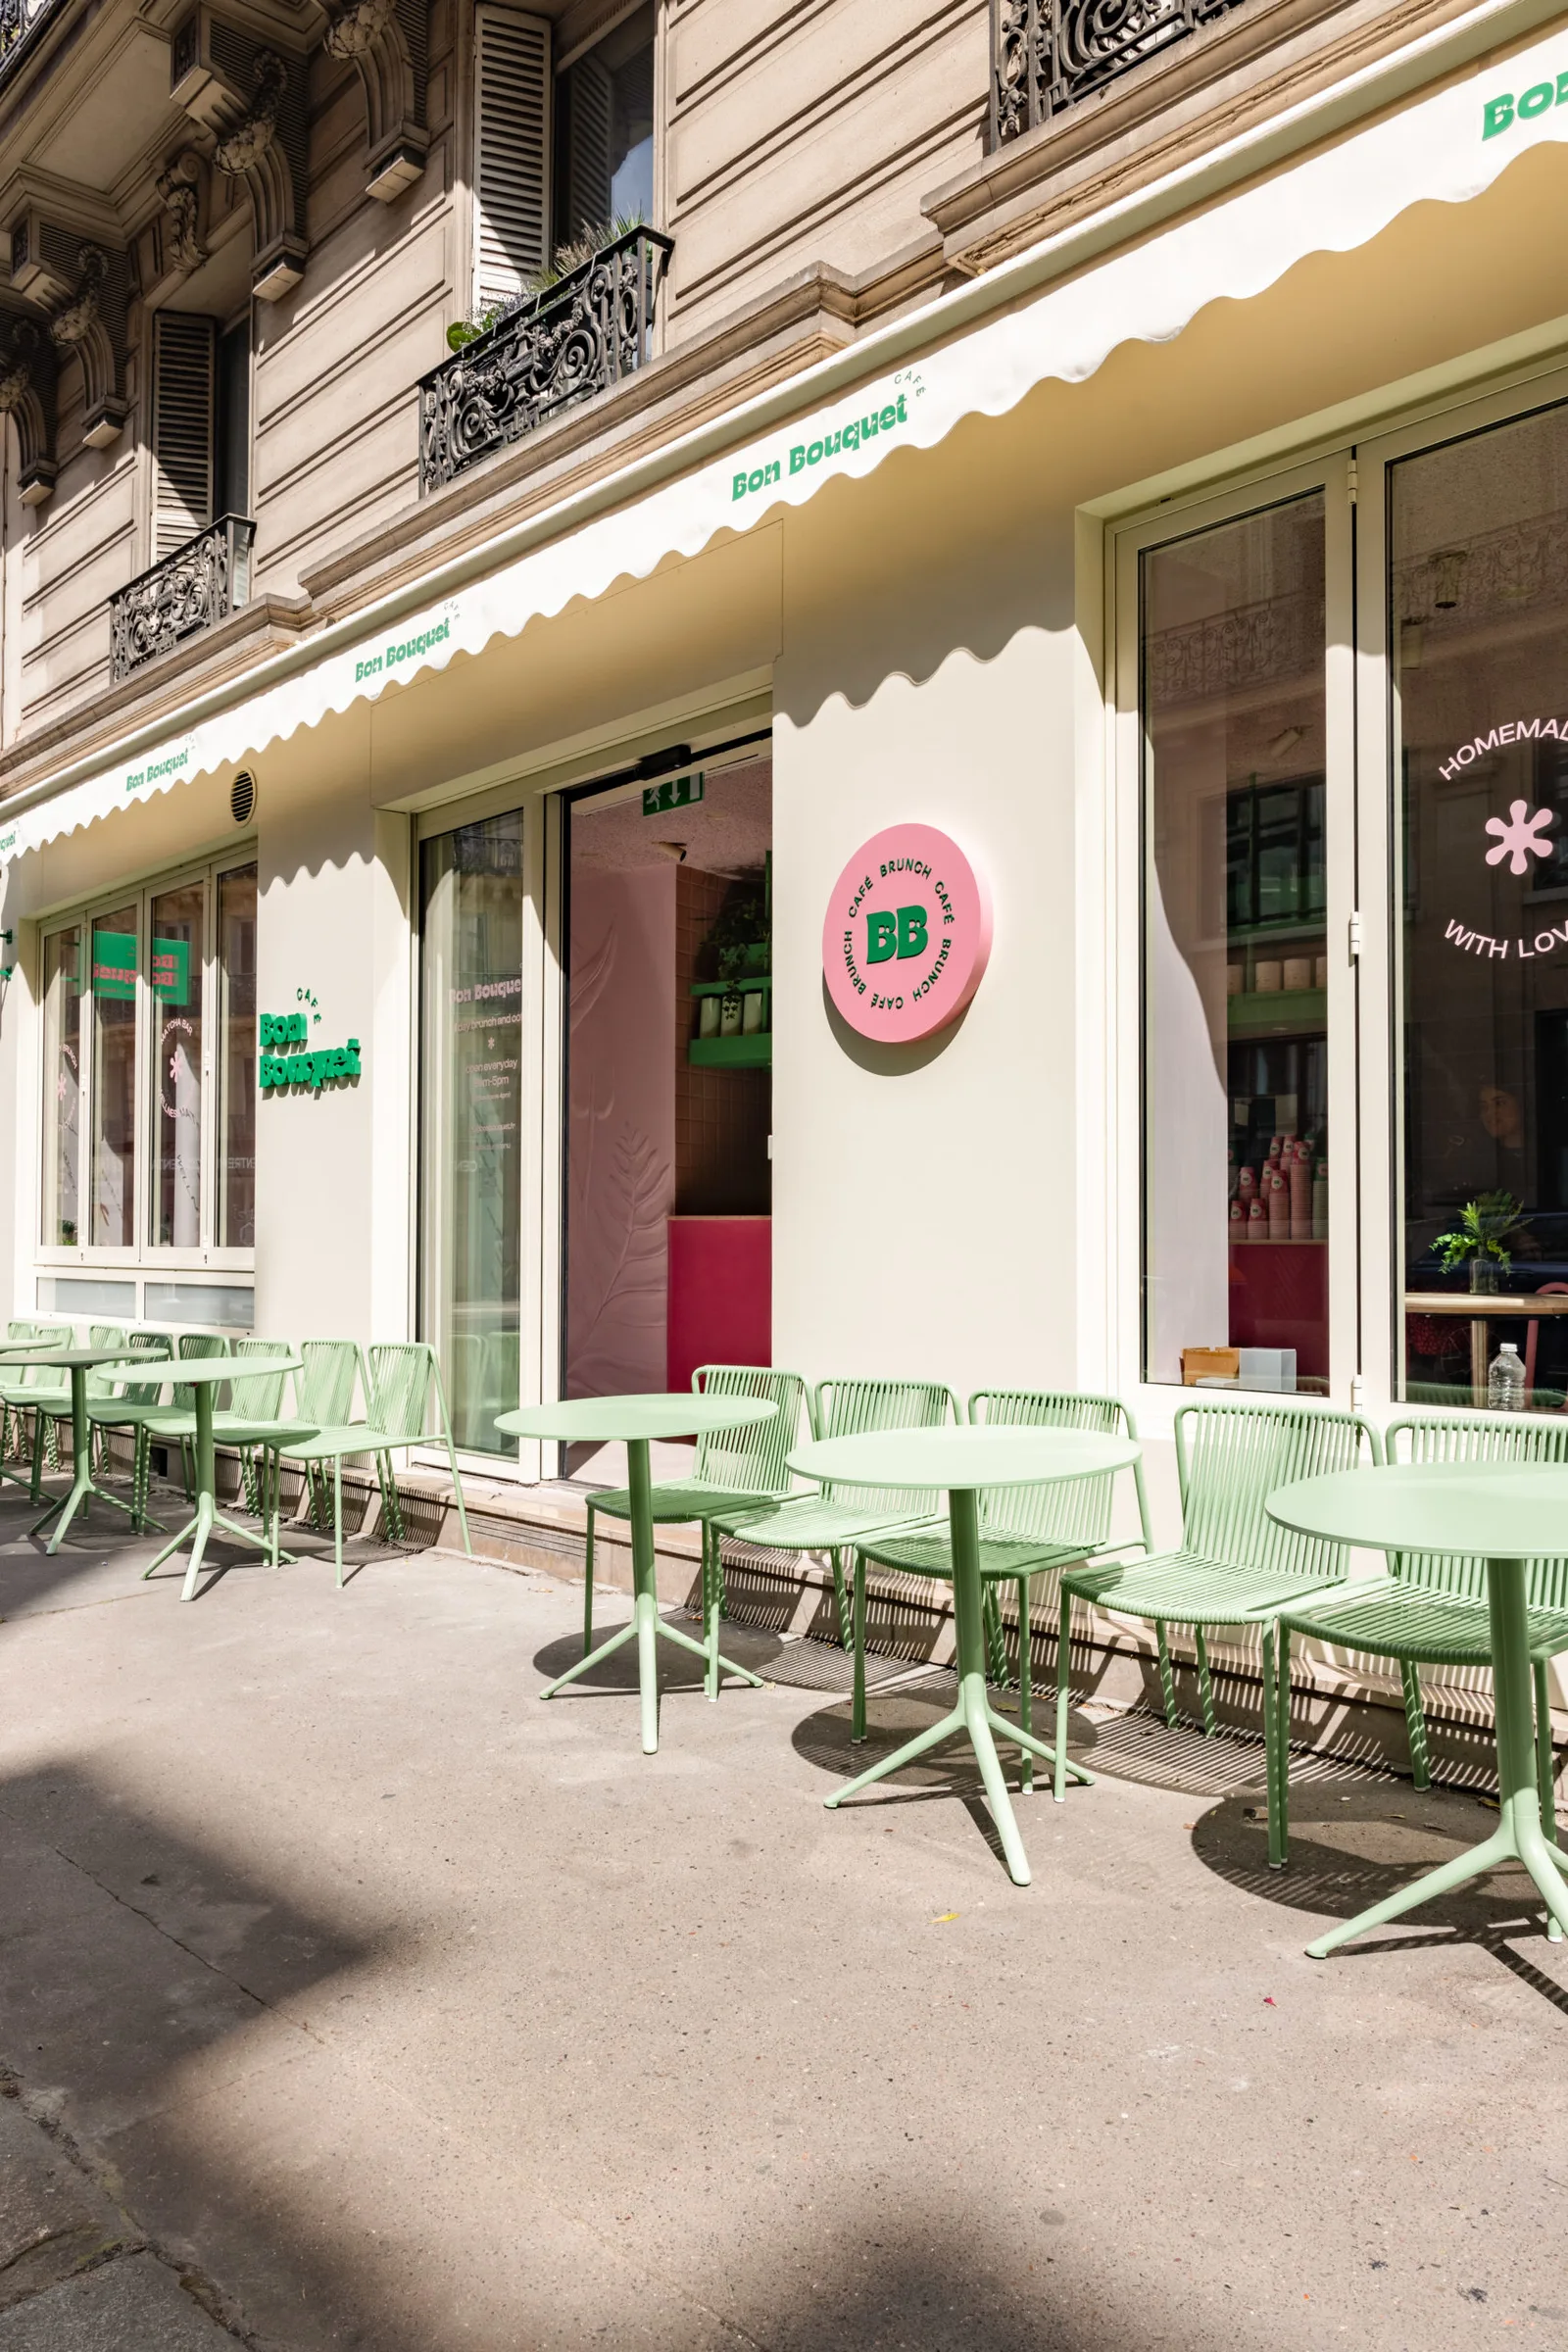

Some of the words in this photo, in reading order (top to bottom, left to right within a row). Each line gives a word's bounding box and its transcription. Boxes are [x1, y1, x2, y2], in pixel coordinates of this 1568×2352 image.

[732, 461, 781, 502] Bon
[789, 393, 907, 476] Bouquet
[355, 656, 383, 683] Bon
[386, 616, 450, 668] Bouquet
[125, 771, 145, 792] Bon
[146, 747, 188, 783] Bouquet
[879, 858, 933, 880] BRUNCH
[848, 875, 874, 918] CAFÉ
[934, 880, 956, 925] CAFÉ
[866, 905, 929, 965] BB
[1444, 918, 1508, 959] WITH
[843, 930, 867, 996] BRUNCH
[912, 938, 953, 1003] BRUNCH
[870, 993, 905, 1010] CAFÉ
[259, 1012, 308, 1048] Bon
[259, 1038, 362, 1089] Bouquet
[483, 1058, 517, 1071] everyday
